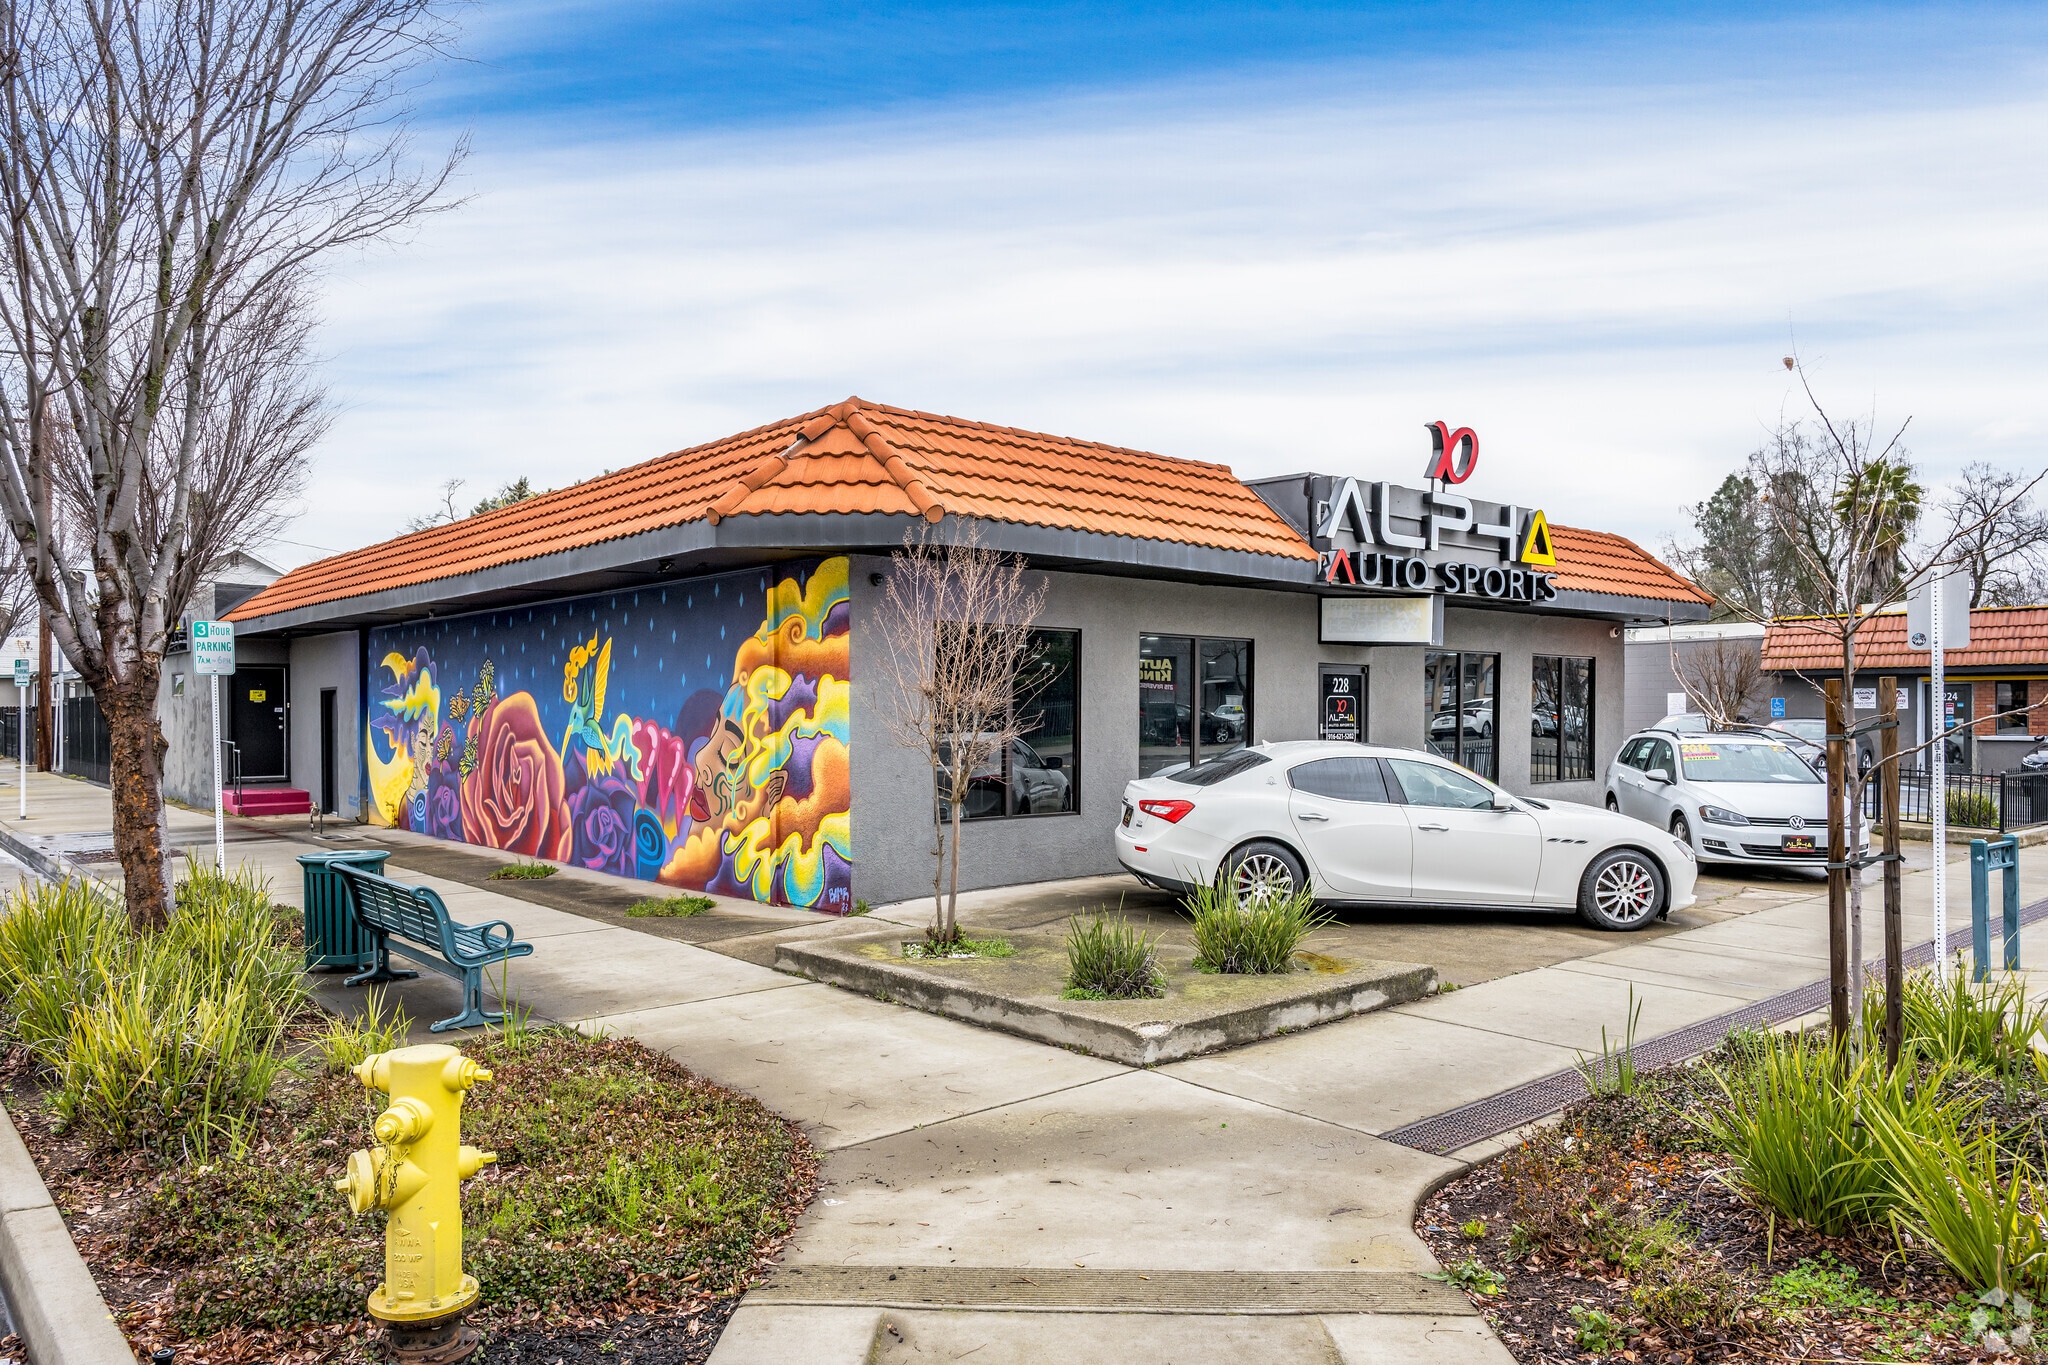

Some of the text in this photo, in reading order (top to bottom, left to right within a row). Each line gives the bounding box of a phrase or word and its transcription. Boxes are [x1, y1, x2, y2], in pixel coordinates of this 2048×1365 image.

[1319, 476, 1557, 567] ALPHA
[1324, 548, 1558, 601] AUTO SPORTS
[197, 624, 231, 636] 3 HOUR
[196, 641, 232, 652] PARKING
[1332, 677, 1349, 693] 228
[1943, 692, 1958, 701] 224
[1328, 713, 1355, 722] ALPHA
[1681, 743, 1711, 753] 2016
[408, 1253, 423, 1263] WP
[398, 1278, 416, 1289] USA
